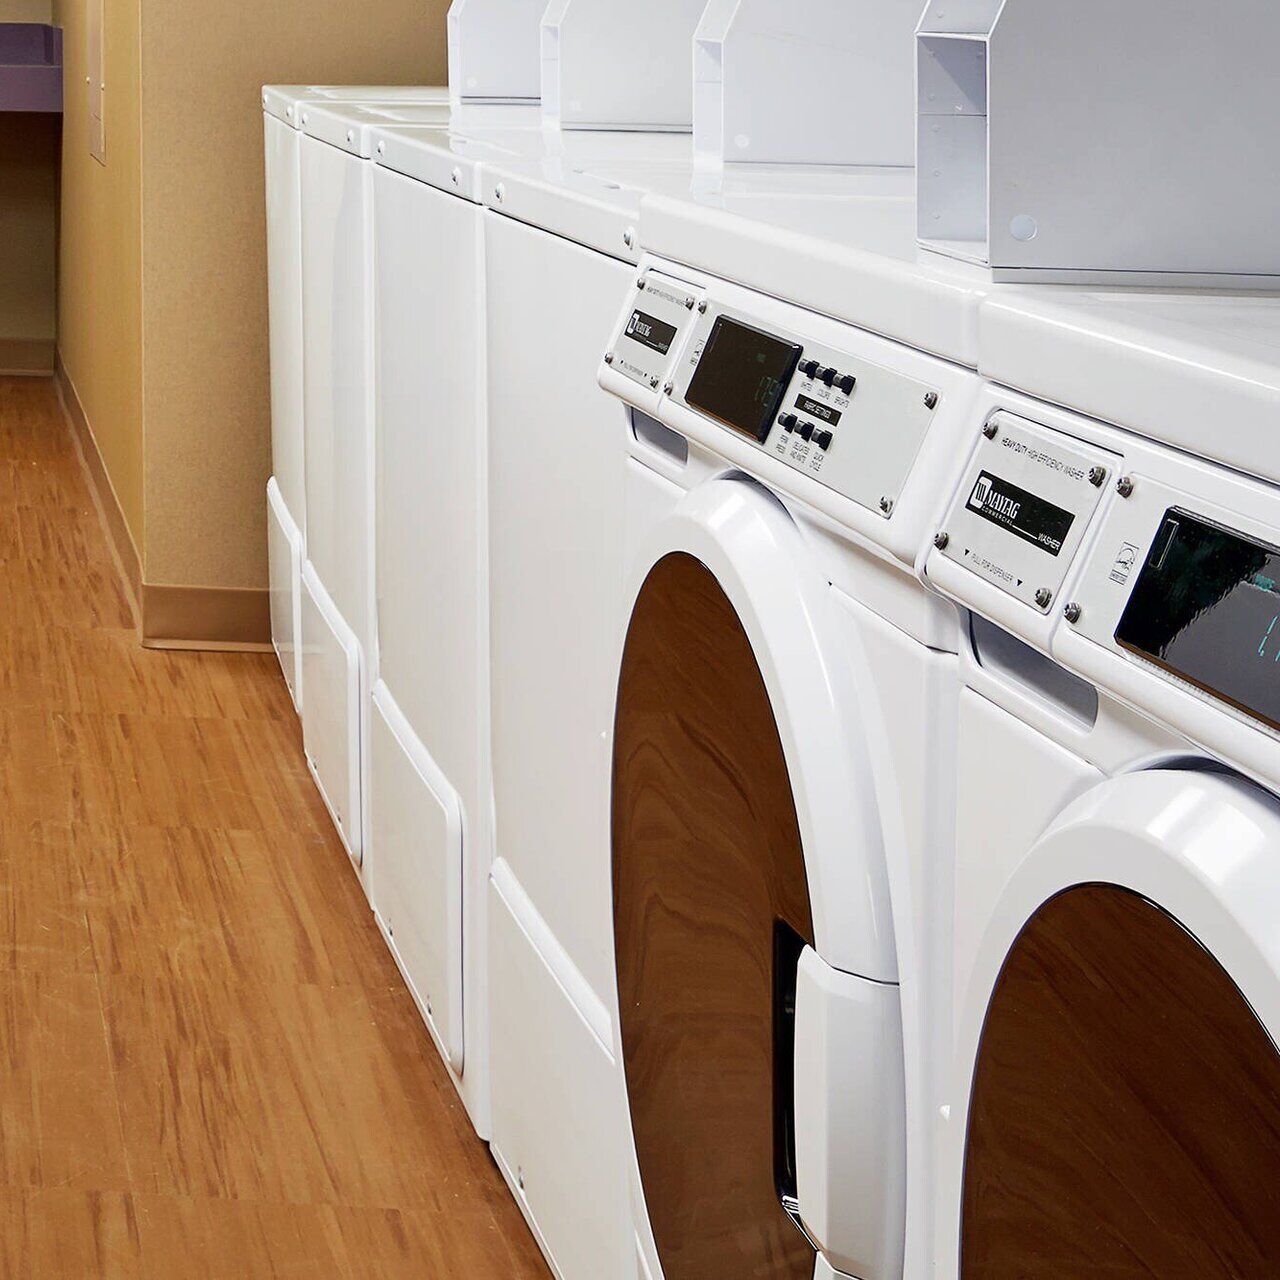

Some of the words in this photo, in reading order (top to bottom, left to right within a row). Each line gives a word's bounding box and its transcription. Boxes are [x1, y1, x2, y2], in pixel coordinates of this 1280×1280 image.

[984, 489, 1021, 519] MAYTAG
[981, 505, 1013, 526] COMMERCIAL
[1037, 532, 1061, 551] WASHER
